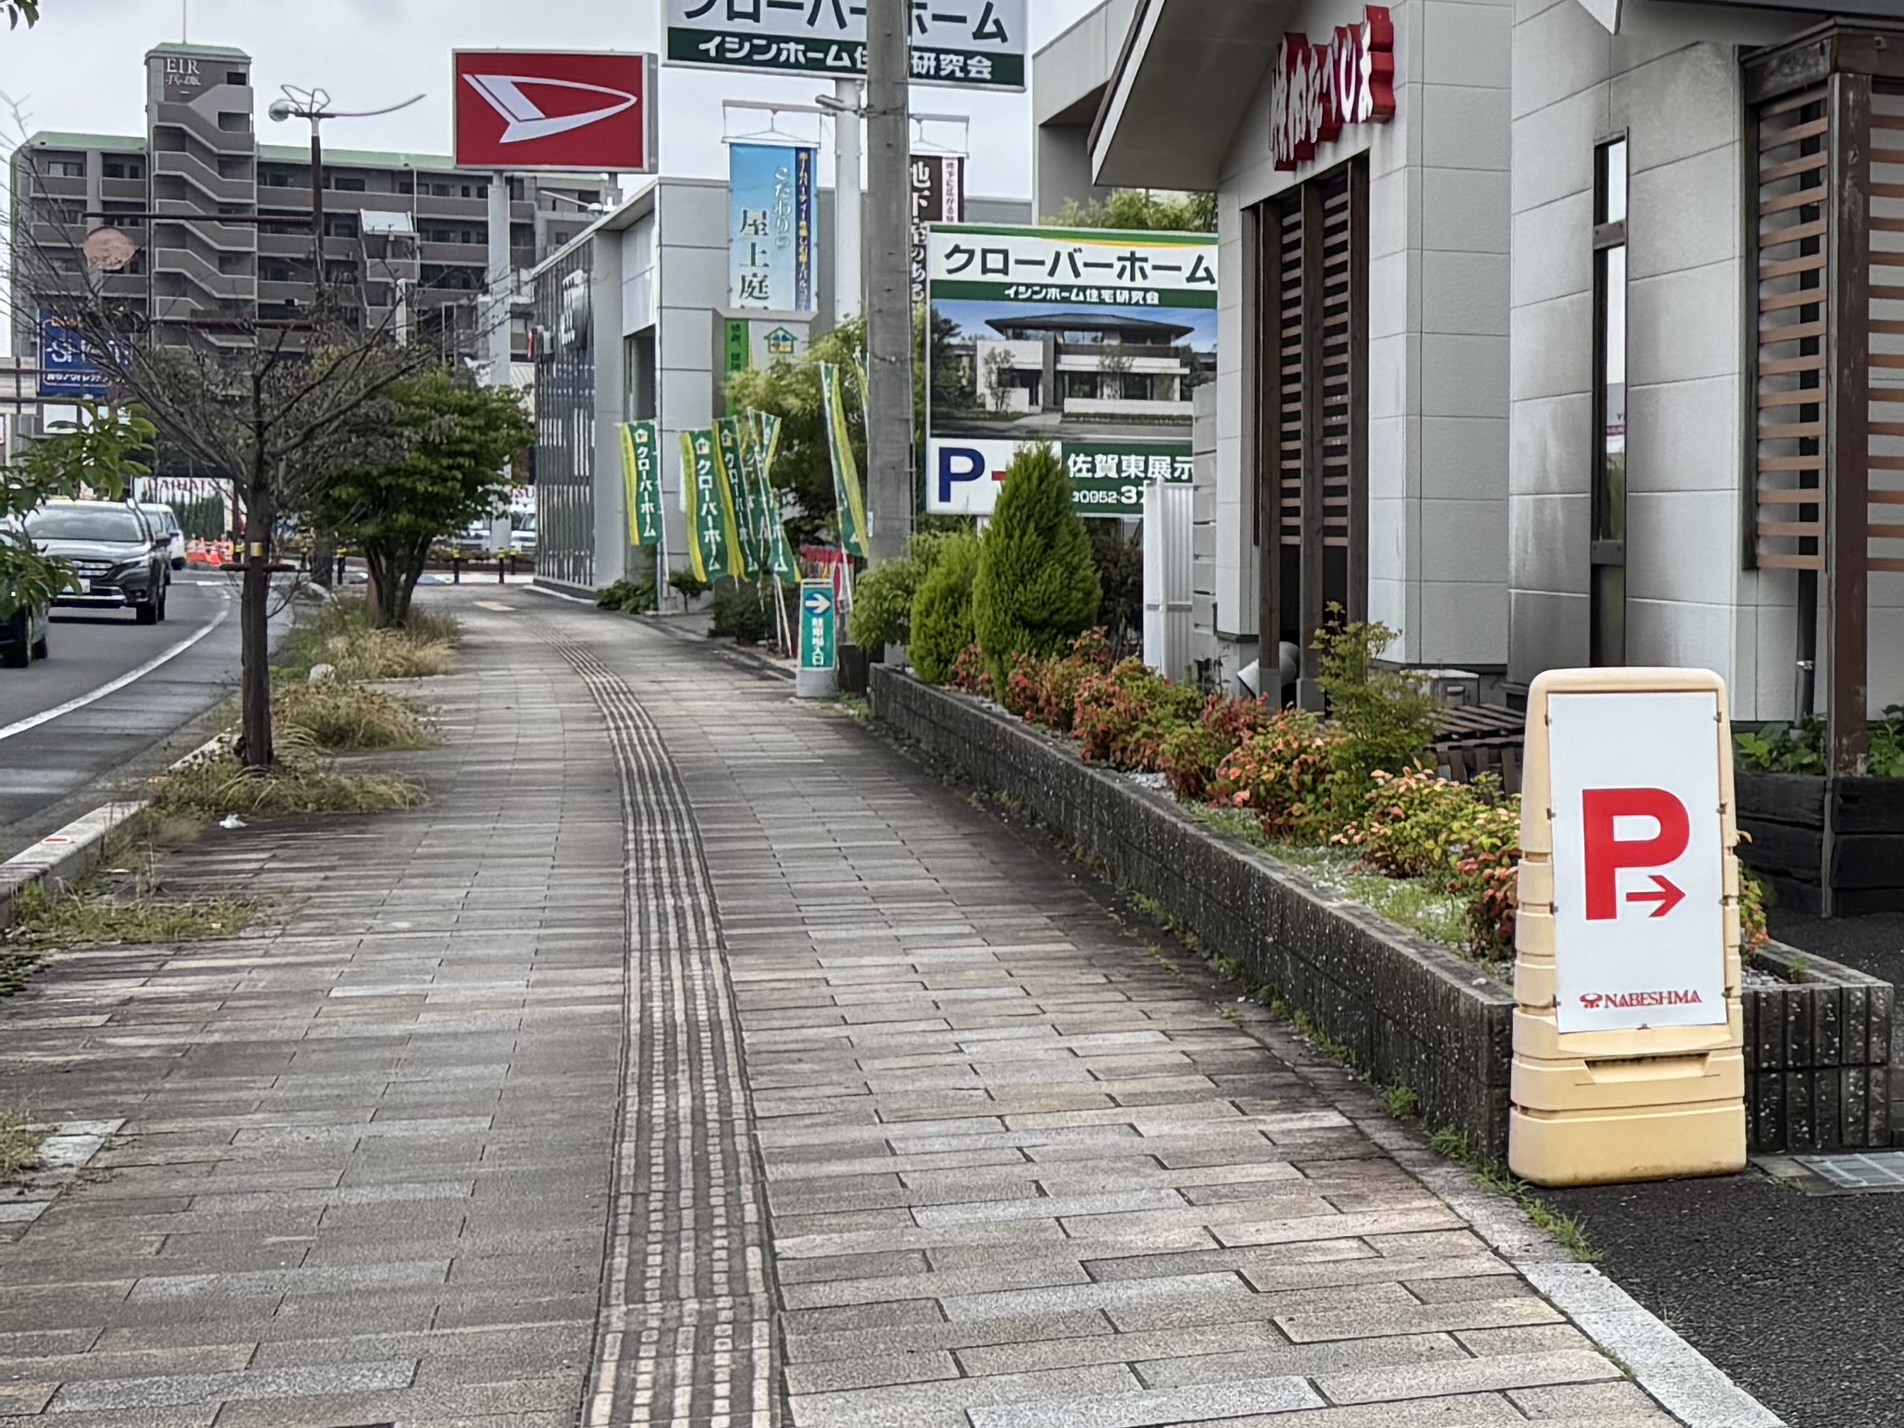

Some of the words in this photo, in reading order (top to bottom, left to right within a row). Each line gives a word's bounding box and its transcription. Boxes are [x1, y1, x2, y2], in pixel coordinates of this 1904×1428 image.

[166, 58, 200, 74] EIR
[698, 35, 993, 80] イシンホーム研究会
[740, 209, 770, 310] 屋上庭
[944, 243, 1216, 285] クローバーホーム
[1004, 285, 1160, 305] イシンホーム住宅研究会
[637, 446, 657, 537] クローバーホーム
[938, 447, 986, 504] P
[697, 459, 721, 571] クローバーホーム
[1582, 787, 1690, 921] P
[1604, 989, 1703, 1010] NABESHIMA
